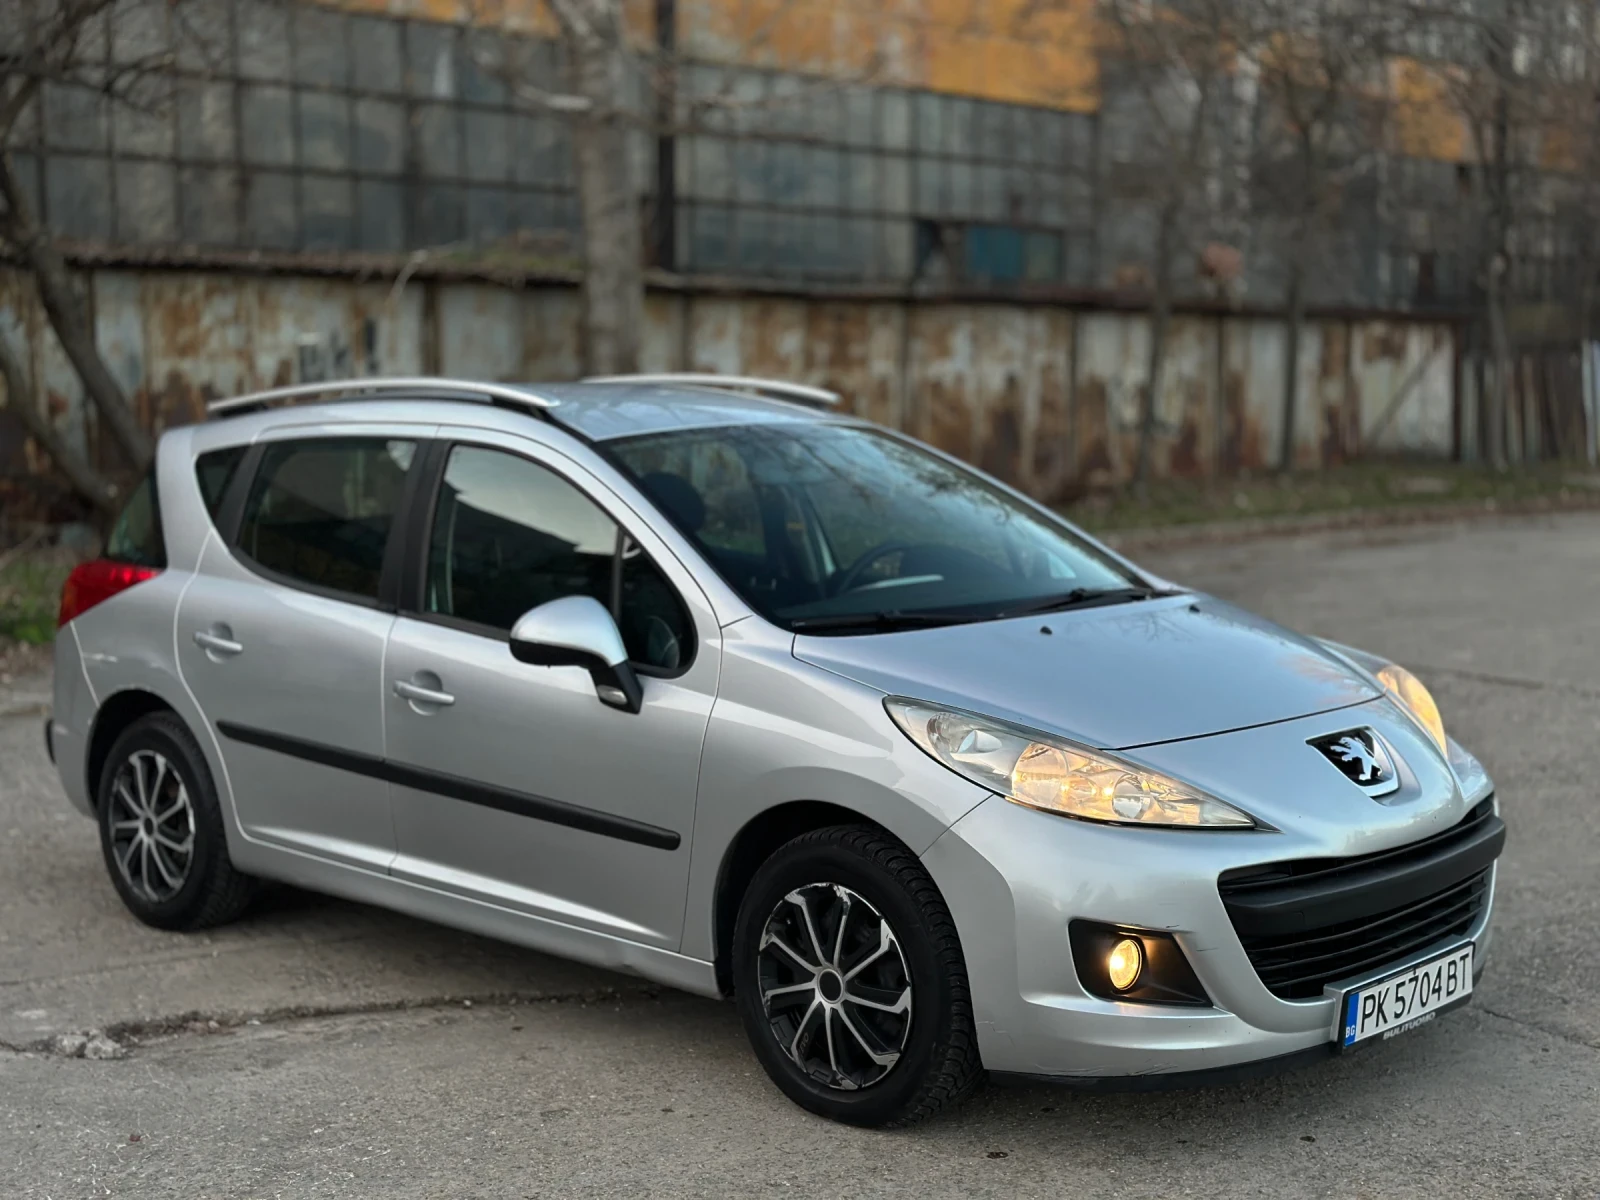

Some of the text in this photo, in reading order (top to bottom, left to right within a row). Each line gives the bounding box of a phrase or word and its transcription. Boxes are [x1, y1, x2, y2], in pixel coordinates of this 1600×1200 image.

[1360, 952, 1470, 1033] PK 5704 BT
[1345, 1025, 1356, 1038] BG
